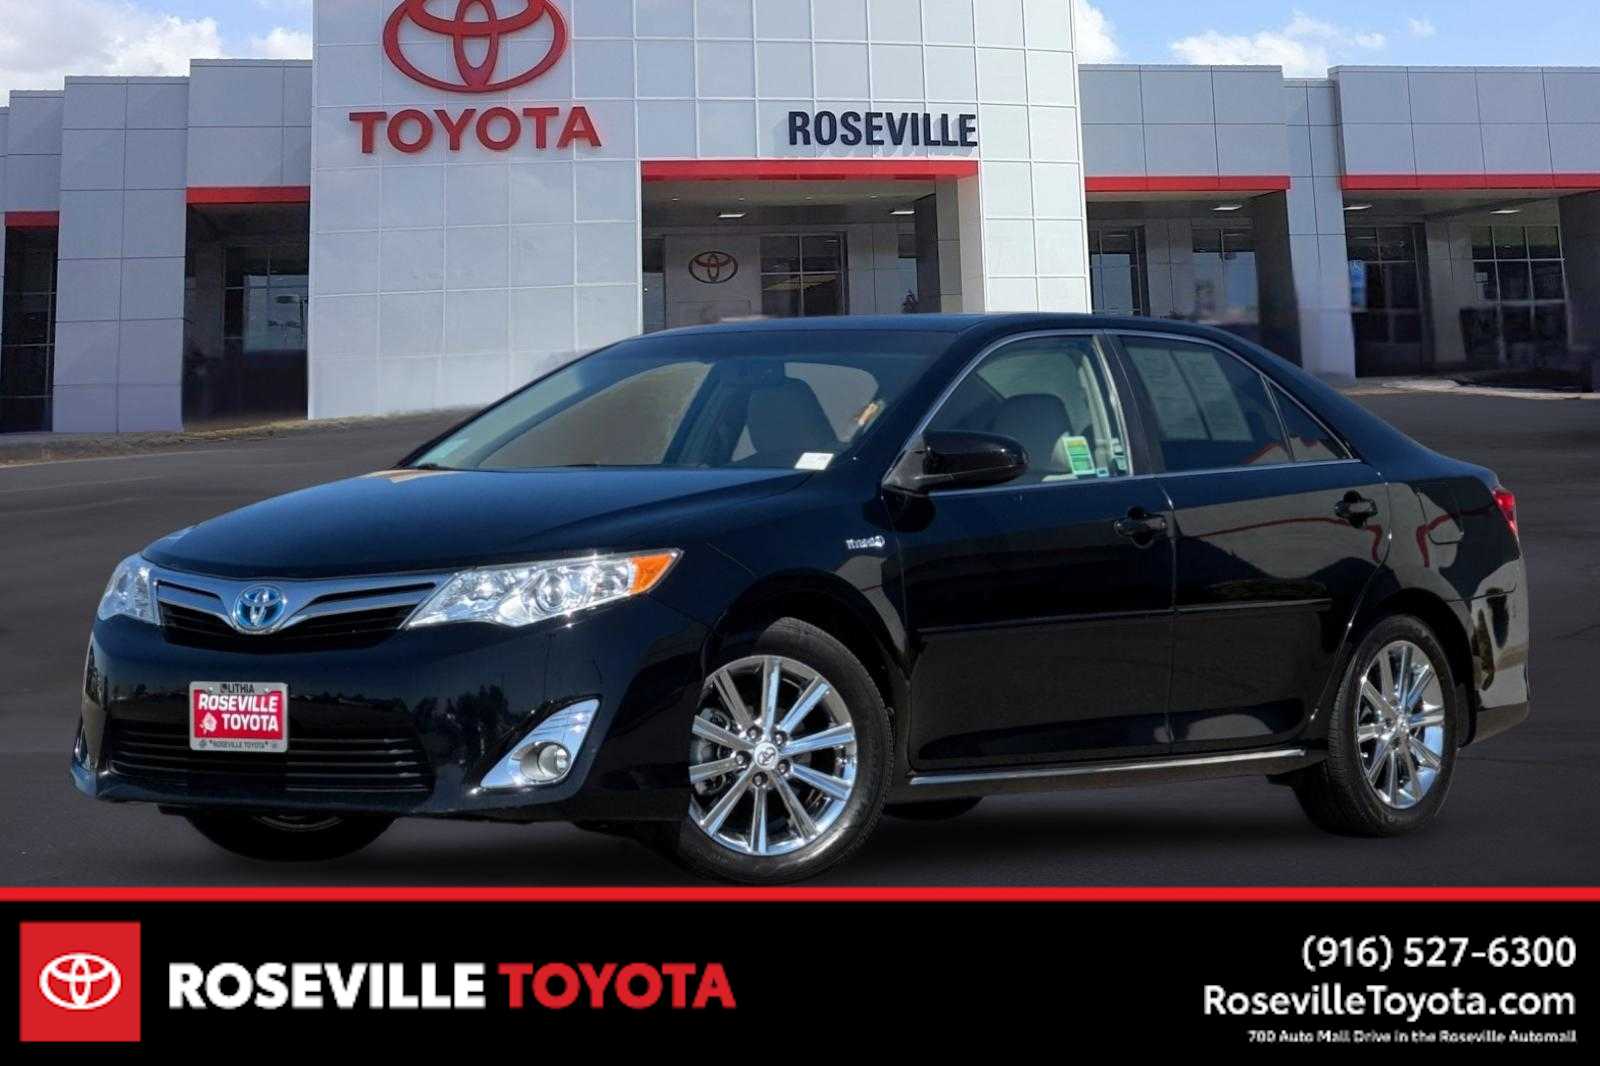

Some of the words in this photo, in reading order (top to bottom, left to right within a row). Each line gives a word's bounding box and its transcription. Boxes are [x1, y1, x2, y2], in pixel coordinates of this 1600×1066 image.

[349, 106, 602, 154] TOYOTA
[788, 110, 978, 147] ROSEVILLE
[228, 683, 255, 693] LITHIA
[198, 693, 279, 713] ROSEVILLE
[221, 713, 279, 732] TOYOTA
